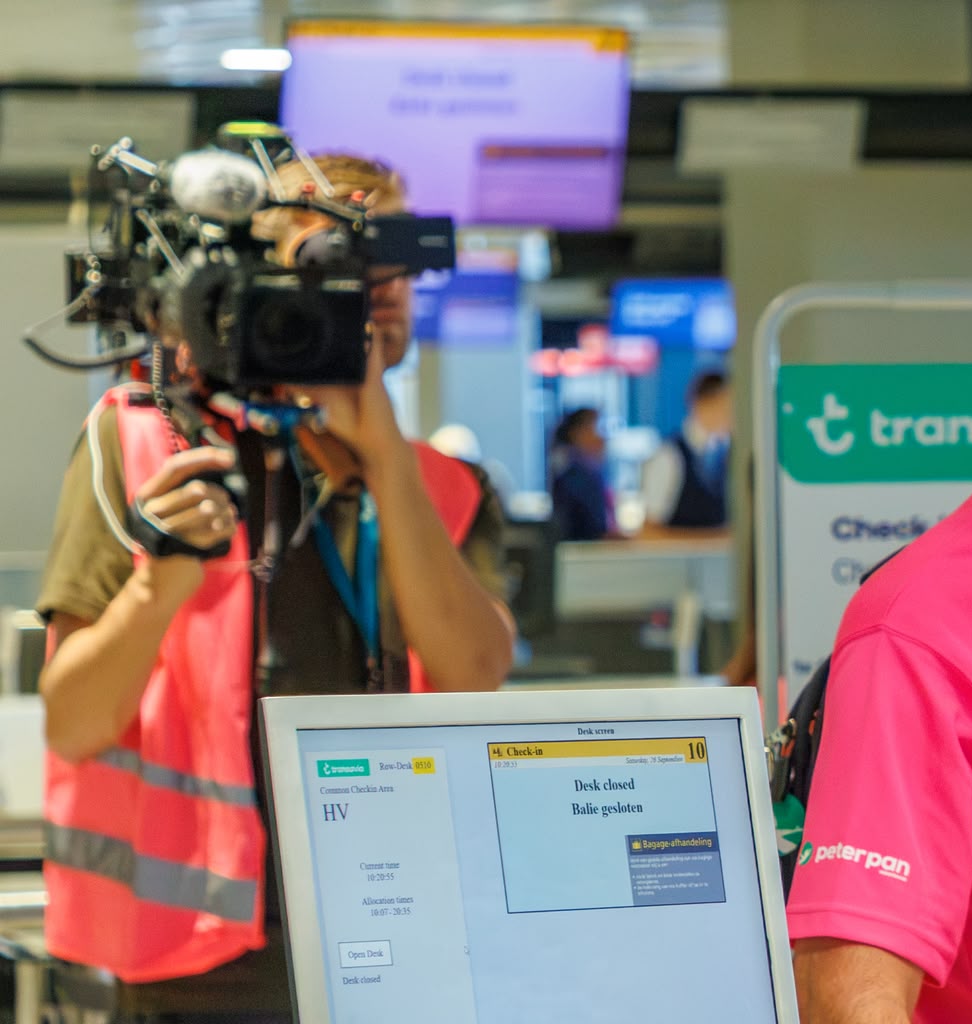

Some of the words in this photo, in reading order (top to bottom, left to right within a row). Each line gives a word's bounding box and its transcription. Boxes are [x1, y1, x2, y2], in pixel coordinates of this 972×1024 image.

[830, 515, 928, 541] Check
[577, 727, 594, 735] Desk
[506, 746, 543, 757] Check-in
[688, 742, 705, 759] 10
[320, 786, 350, 794] Common
[350, 785, 377, 793] Checkin
[574, 779, 601, 791] Desk
[603, 778, 635, 791] closed
[323, 803, 349, 821] HV
[572, 803, 599, 815] Balie
[602, 801, 643, 817] gesloten
[642, 837, 712, 850] Bagage-afhandeling
[360, 862, 384, 870] Current
[385, 861, 400, 869] time
[362, 897, 395, 906] Allocation
[396, 896, 414, 904] times
[348, 950, 366, 960] Open
[367, 950, 384, 958] Desk
[342, 976, 359, 985] Desk
[360, 975, 381, 984] closed
